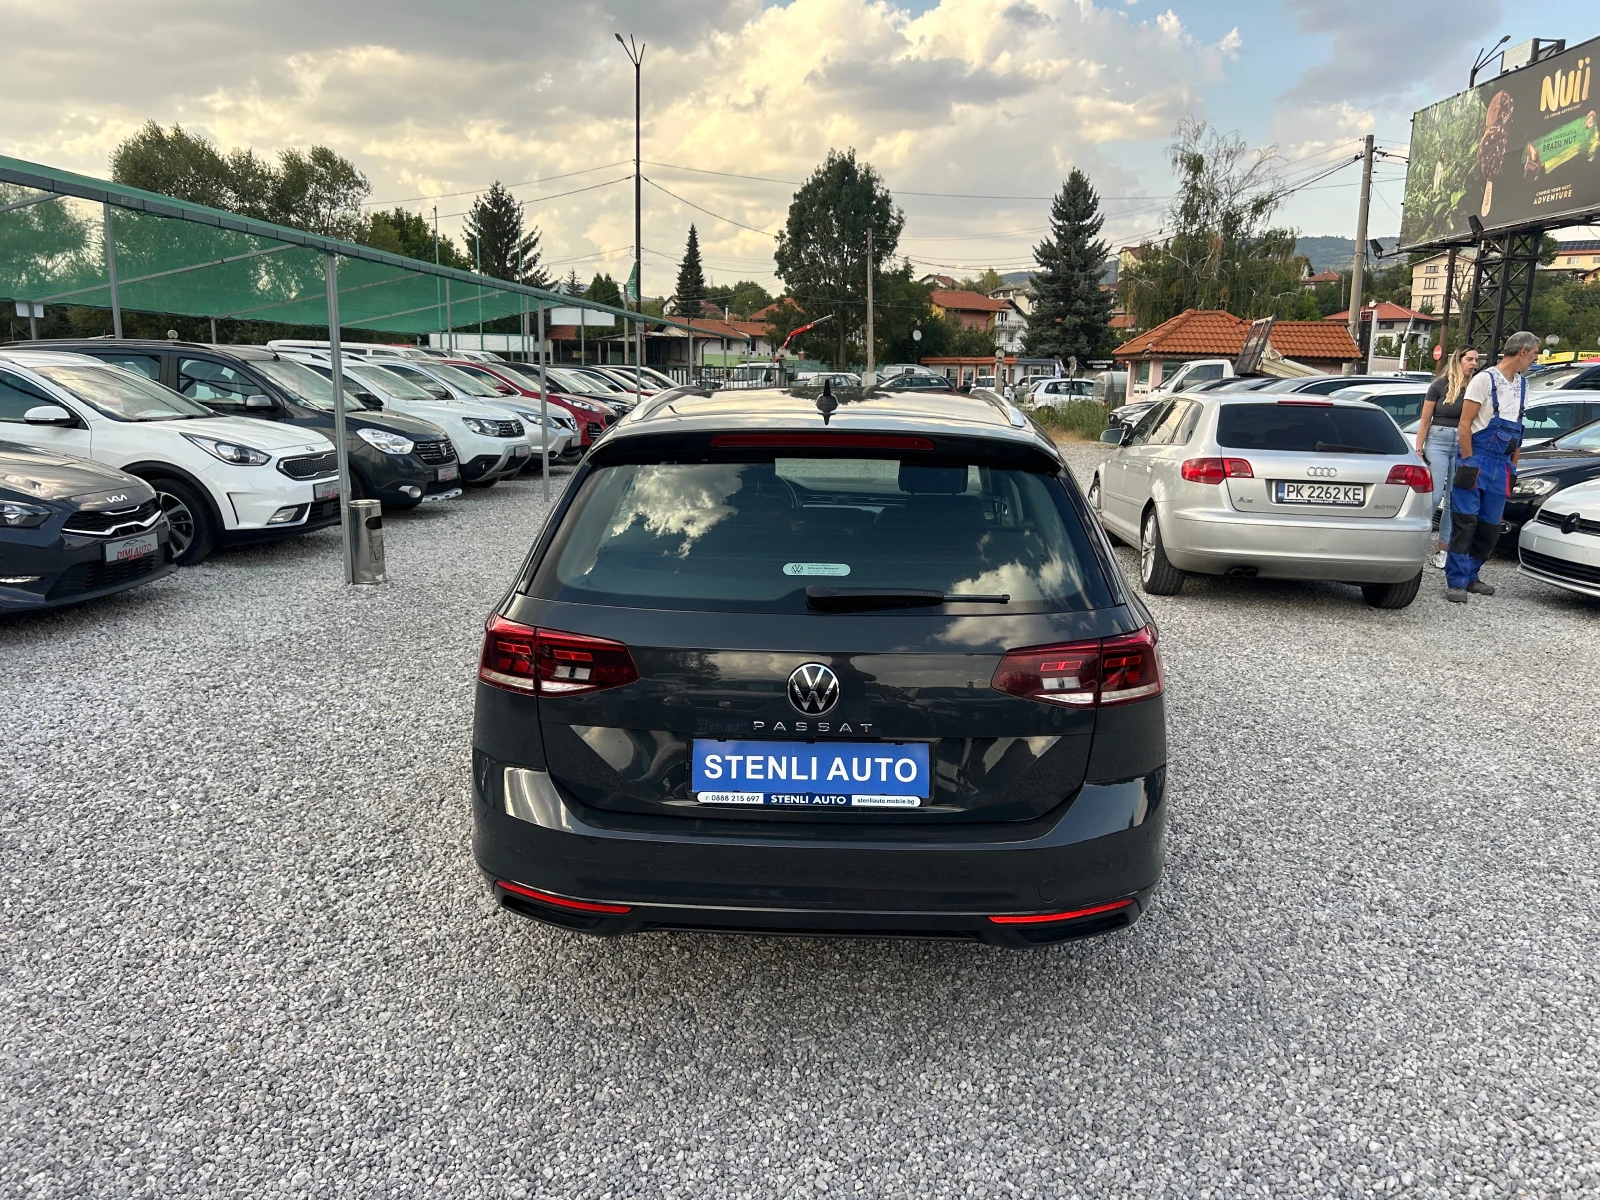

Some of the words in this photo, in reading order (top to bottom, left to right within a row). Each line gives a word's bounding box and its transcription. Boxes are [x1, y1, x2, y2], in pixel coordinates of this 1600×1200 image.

[1540, 56, 1591, 112] Nuii
[1542, 140, 1563, 152] BRAZIL
[1563, 135, 1577, 146] NUT
[1533, 189, 1572, 205] ADVENTURE
[1286, 484, 1305, 498] PK
[1307, 485, 1341, 500] 2262
[1343, 487, 1362, 501] KE
[753, 720, 873, 733] PASSAT
[703, 753, 818, 781] STENLI
[826, 756, 918, 783] AUTO
[711, 794, 729, 802] 0888
[746, 795, 760, 803] 697
[770, 793, 810, 804] STENLI
[812, 794, 847, 805] AUTO
